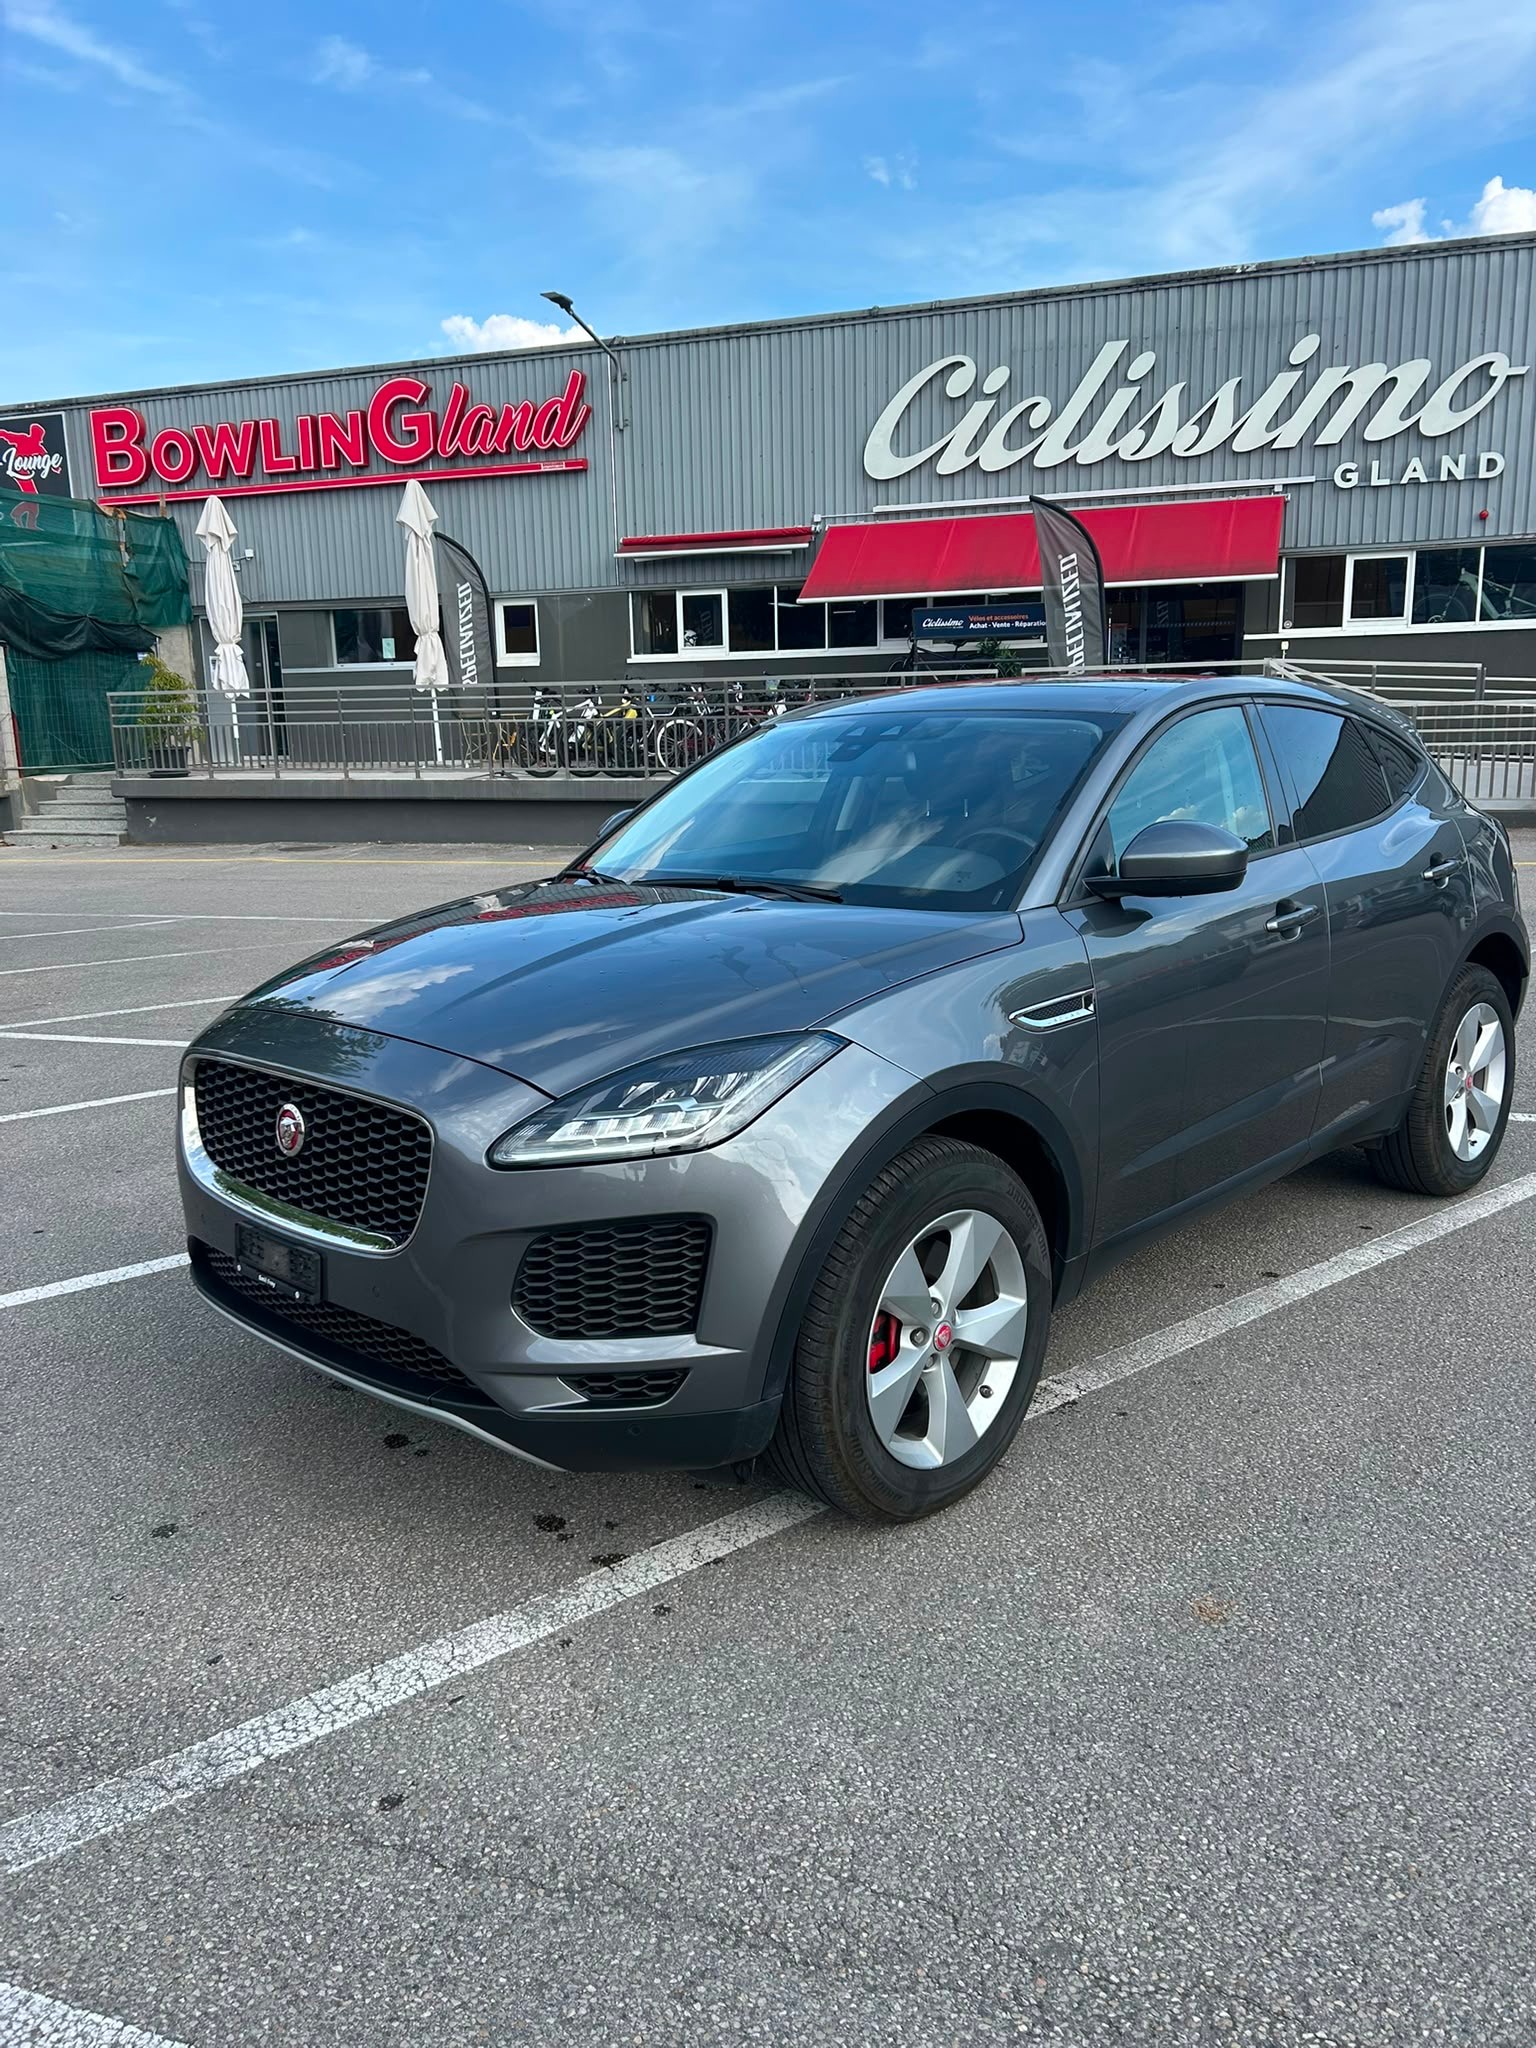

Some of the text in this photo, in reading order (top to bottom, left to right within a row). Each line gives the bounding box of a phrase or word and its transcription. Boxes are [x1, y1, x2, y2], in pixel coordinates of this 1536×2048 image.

[863, 333, 1530, 480] Ciclissimo
[1333, 451, 1506, 489] GLAND
[922, 617, 964, 628] Ciclissimo
[969, 621, 988, 629] Achat
[1015, 619, 1046, 628] Réparatio
